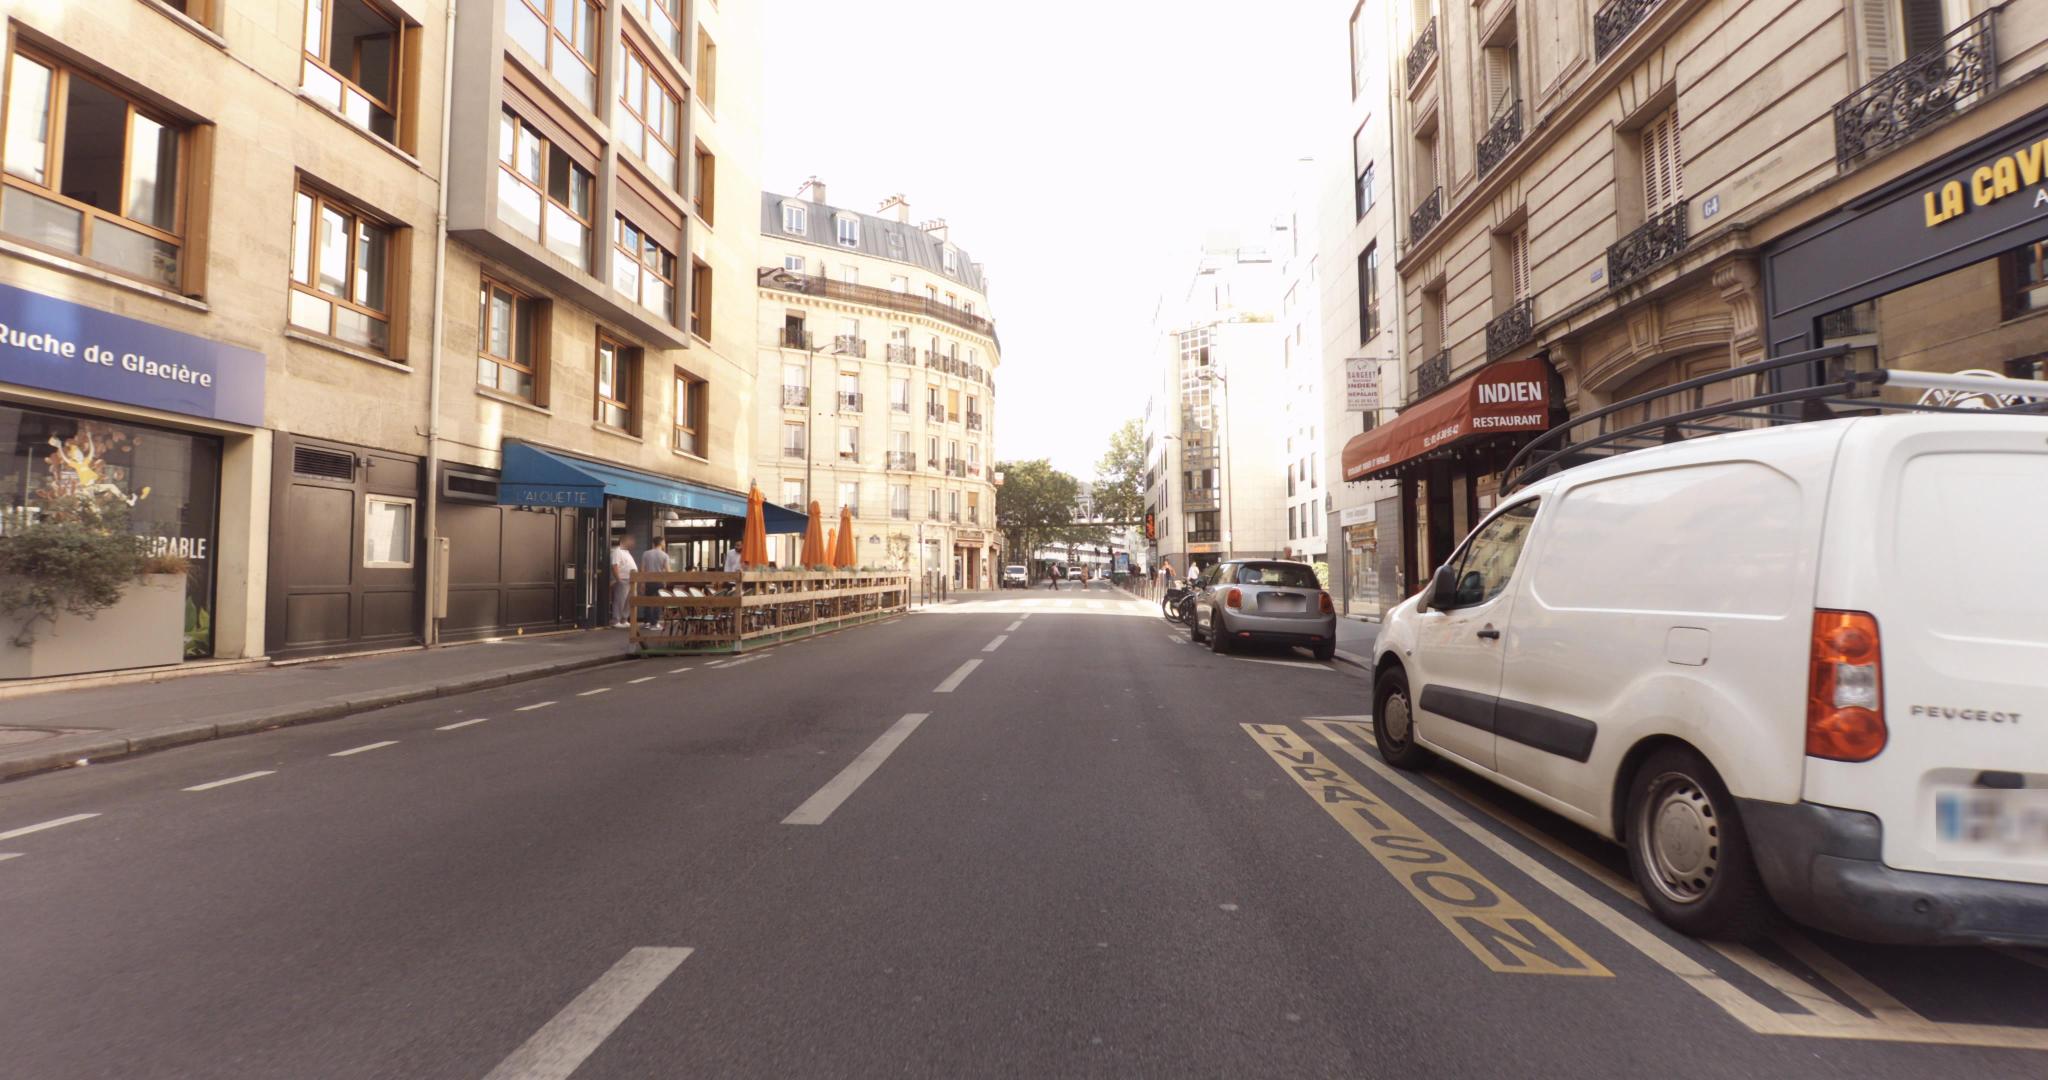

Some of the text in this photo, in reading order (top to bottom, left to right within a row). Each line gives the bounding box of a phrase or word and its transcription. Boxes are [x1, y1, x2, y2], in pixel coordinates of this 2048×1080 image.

[1704, 197, 1719, 217] 64
[1924, 180, 1965, 228] LA
[83, 345, 114, 366] de
[121, 353, 211, 387] Glacière
[1478, 381, 1542, 404] INDIEN
[1472, 414, 1542, 428] RESTAURANT
[1910, 704, 2021, 724] PEUGEOT
[1250, 724, 1589, 969] LIVRAISON
